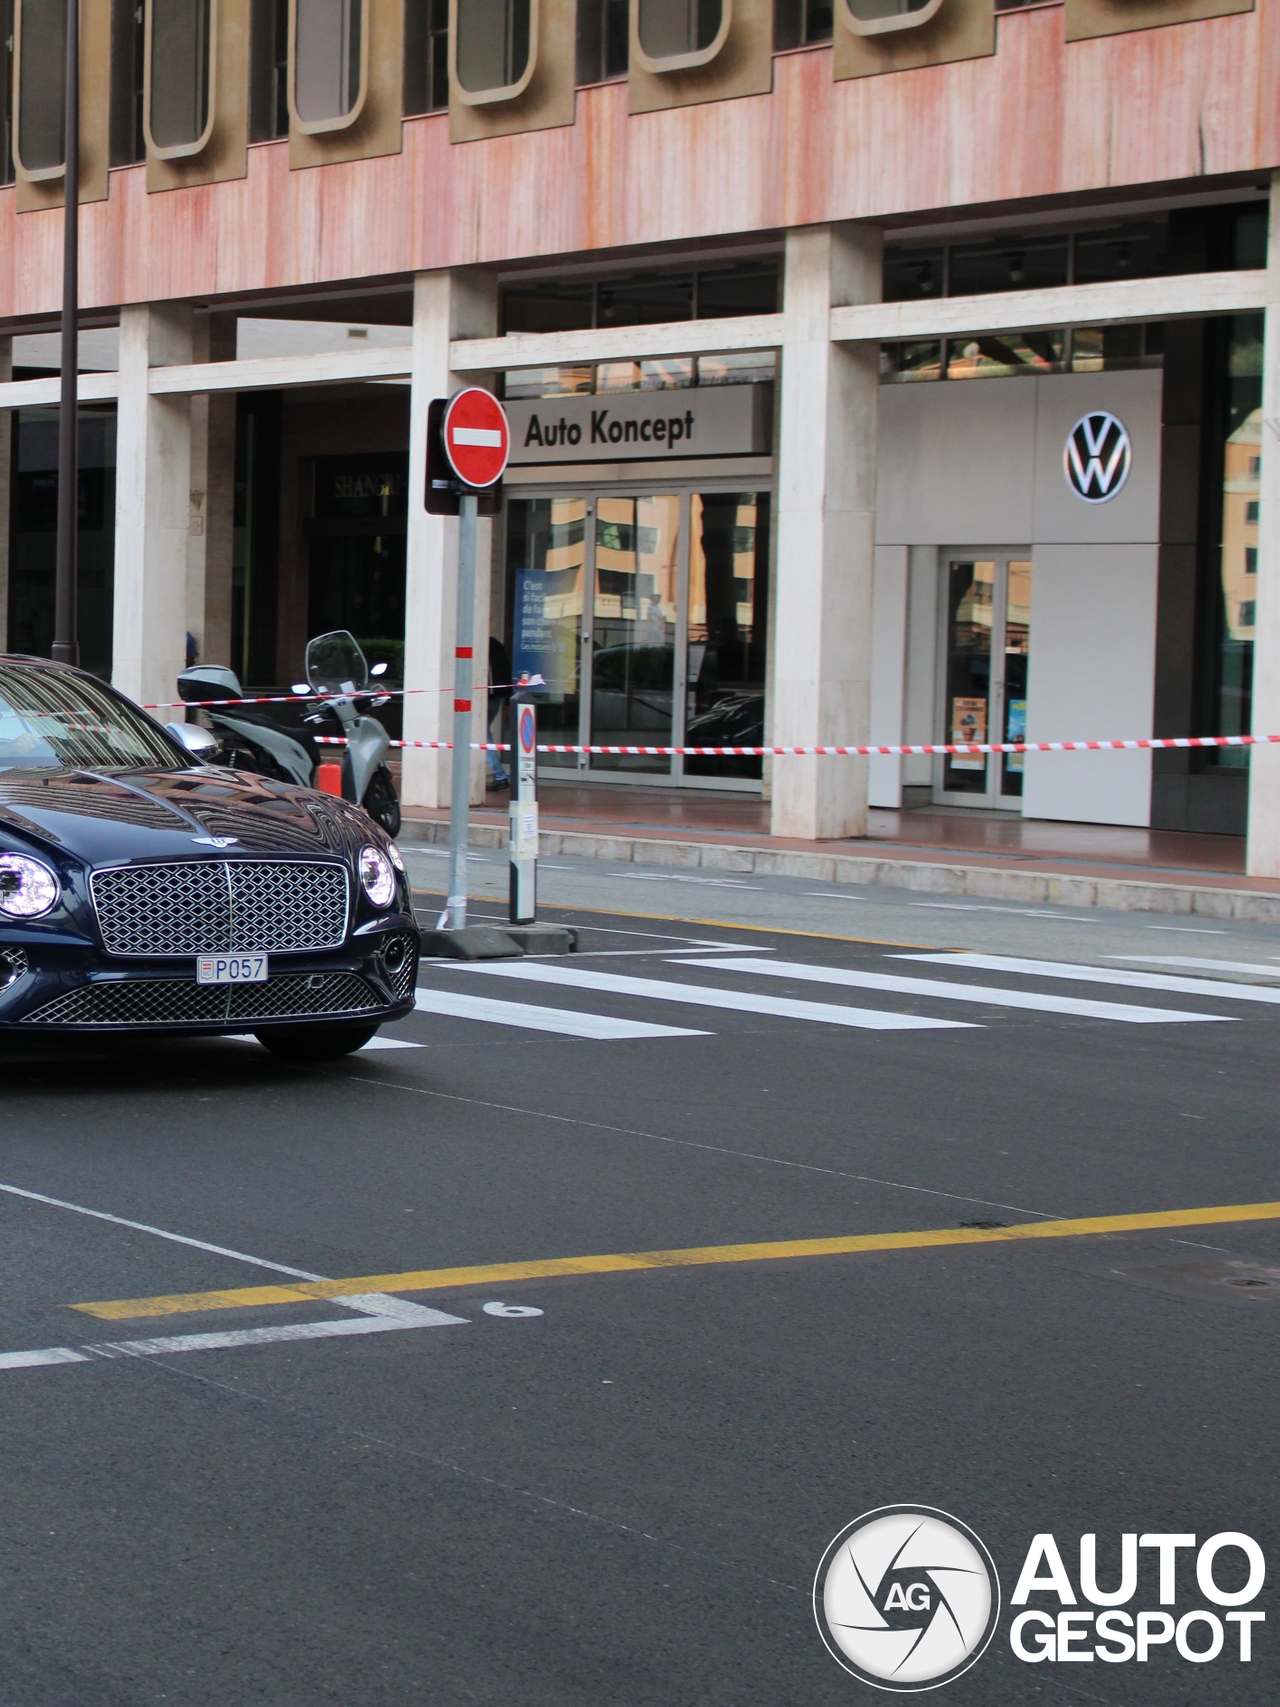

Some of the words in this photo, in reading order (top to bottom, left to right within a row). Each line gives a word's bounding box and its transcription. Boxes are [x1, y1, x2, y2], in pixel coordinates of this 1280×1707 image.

[524, 413, 582, 448] Auto
[590, 409, 694, 450] Koncept
[216, 958, 264, 979] P057
